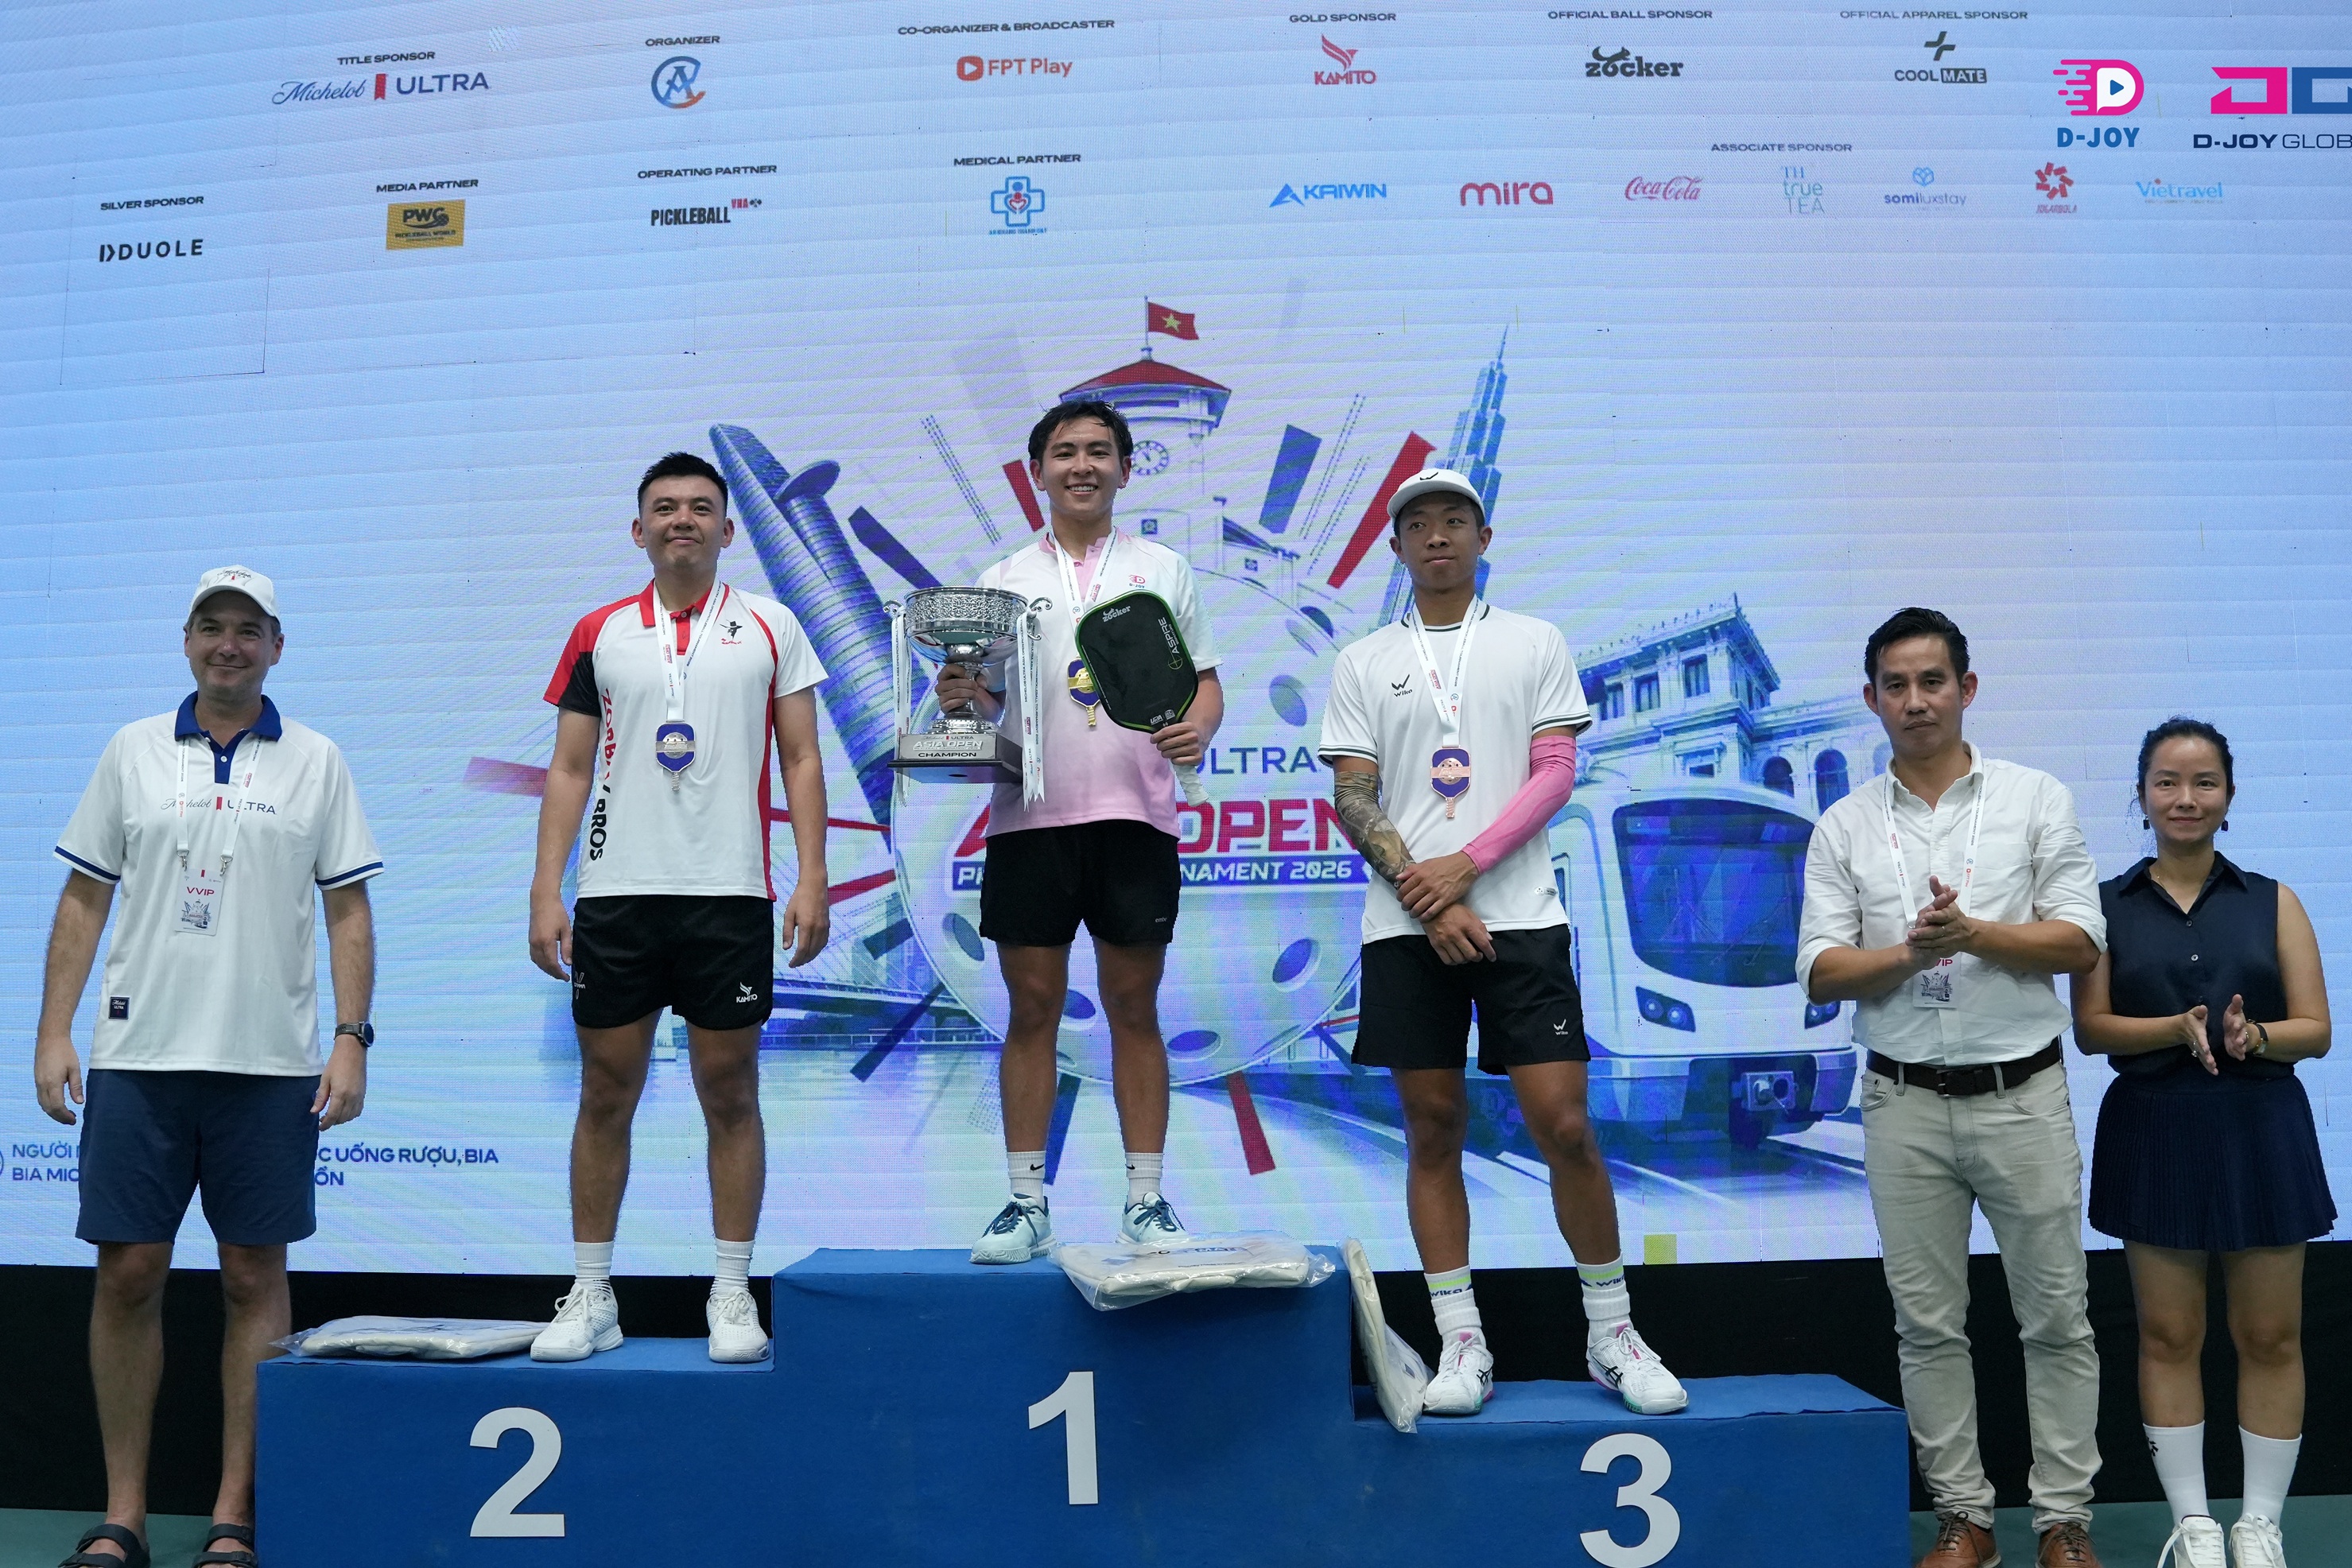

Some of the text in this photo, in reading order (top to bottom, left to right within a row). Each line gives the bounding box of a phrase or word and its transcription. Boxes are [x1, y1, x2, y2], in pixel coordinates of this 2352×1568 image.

[1330, 13, 1396, 21] SPONSOR
[1840, 10, 1900, 19] OFFICIAL
[898, 24, 999, 34] CO-ORGANIZER
[1014, 20, 1115, 31] BROADCASTER
[645, 36, 720, 46] ORGANIZER
[337, 52, 436, 65] TITLE SPONSOR
[987, 57, 1073, 78] FPT Play
[1314, 70, 1376, 85] KAMITO
[272, 72, 489, 105] Michelob ULTRA
[2056, 127, 2140, 148] D-JOY
[2193, 134, 2278, 149] D-JOY
[1710, 143, 1853, 152] ASSOCIATE SPONSOR
[953, 153, 1081, 166] MEDICAL PARTNER
[637, 165, 778, 179] OPERATING PARTNER
[376, 179, 479, 193] MEDIA PARTNER
[1303, 184, 1387, 200] KAIWIN
[1460, 182, 1554, 206] mira
[1783, 180, 1823, 196] true
[2134, 177, 2223, 198] Vietravel
[100, 196, 204, 211] SILVER SPONSOR
[1786, 196, 1826, 215] TEA
[1884, 191, 1966, 206] somiluxstay
[650, 207, 731, 227] PICKLEBALL
[118, 239, 204, 259] DUOLE
[1158, 616, 1180, 654] ASPIRE
[161, 798, 277, 815] Mhelob UTRA
[1182, 862, 1284, 881] NAMENT
[1290, 860, 1352, 879] 2026
[187, 887, 215, 896] VVIP
[735, 994, 758, 1003] KAMITO
[13, 1140, 72, 1159] NGƯỜI
[336, 1142, 395, 1162] UỐNG
[464, 1148, 499, 1163] BIA
[13, 1167, 42, 1181] BIA
[1027, 1370, 1100, 1506] 1
[468, 1406, 566, 1539] 2
[1578, 1433, 1682, 1568] 3
